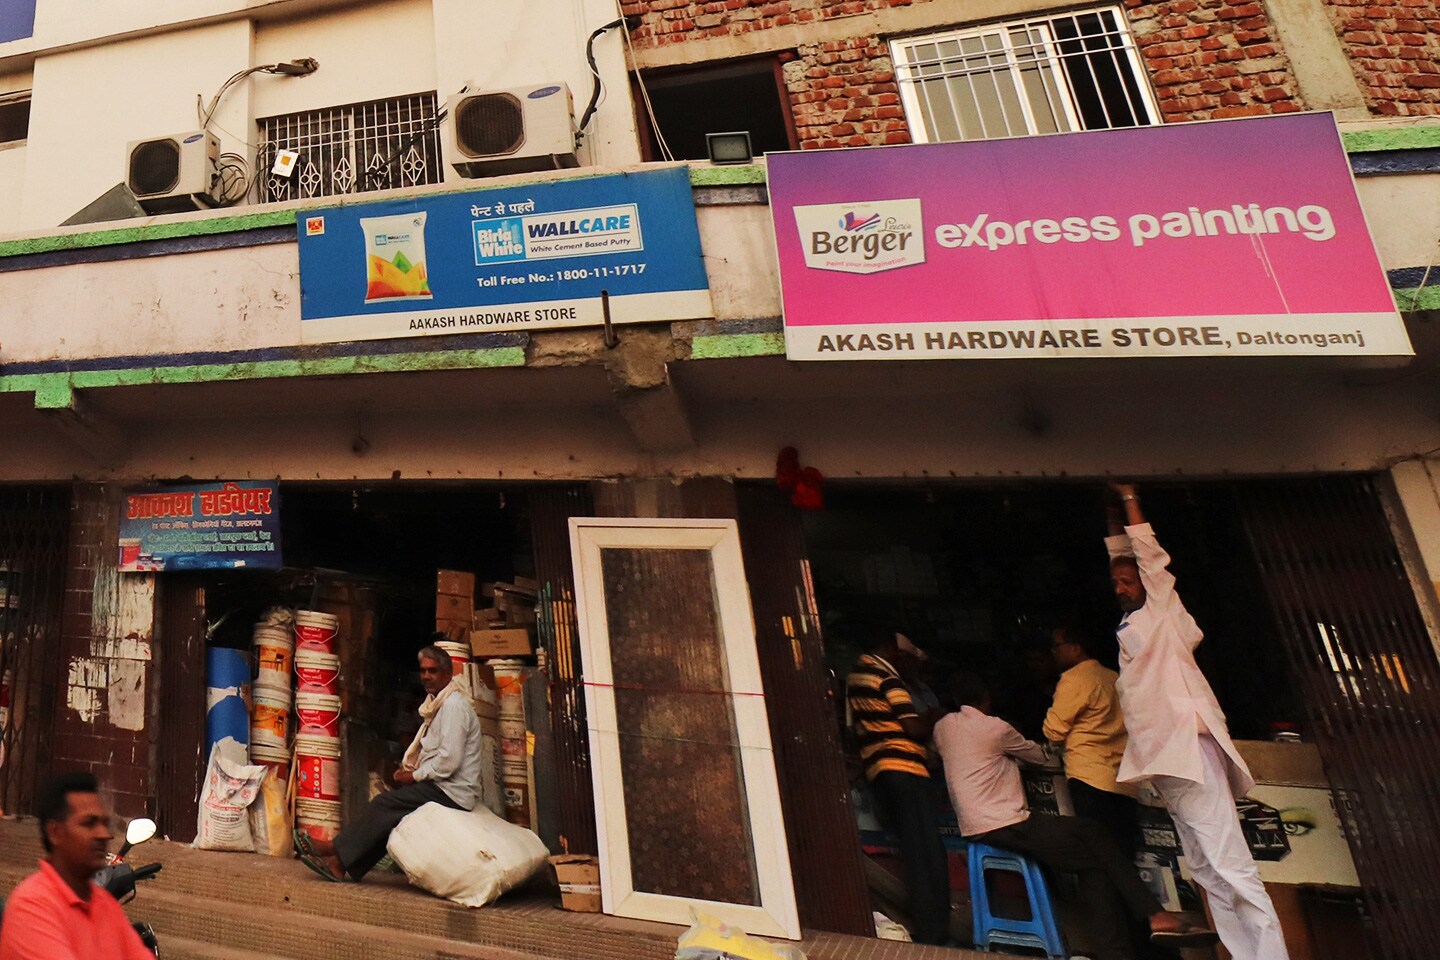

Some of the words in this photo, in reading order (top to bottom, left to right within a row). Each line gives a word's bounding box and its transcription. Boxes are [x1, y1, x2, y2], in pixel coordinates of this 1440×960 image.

[495, 202, 505, 215] से
[509, 199, 535, 214] पहले
[477, 226, 512, 244] Birla
[528, 215, 630, 238] WALLCARE
[934, 213, 1121, 251] express
[1128, 203, 1336, 247] painting
[479, 239, 523, 258] White
[554, 243, 583, 251] Cement
[585, 240, 608, 248] Based
[610, 238, 631, 247] Putty
[812, 230, 912, 260] Berger
[863, 257, 907, 268] imagination
[477, 277, 497, 288] Toll
[501, 275, 526, 286] Free
[557, 263, 646, 281] 1800-11-1717
[409, 316, 456, 330] AAKASH
[459, 310, 531, 326] HARDWARE
[535, 307, 577, 321] STORE
[817, 332, 914, 352] AKASH
[925, 328, 1101, 350] HARDWARE
[1111, 326, 1231, 349] STORE,
[1237, 329, 1366, 348] Daltonganj
[128, 492, 195, 519] आकाश
